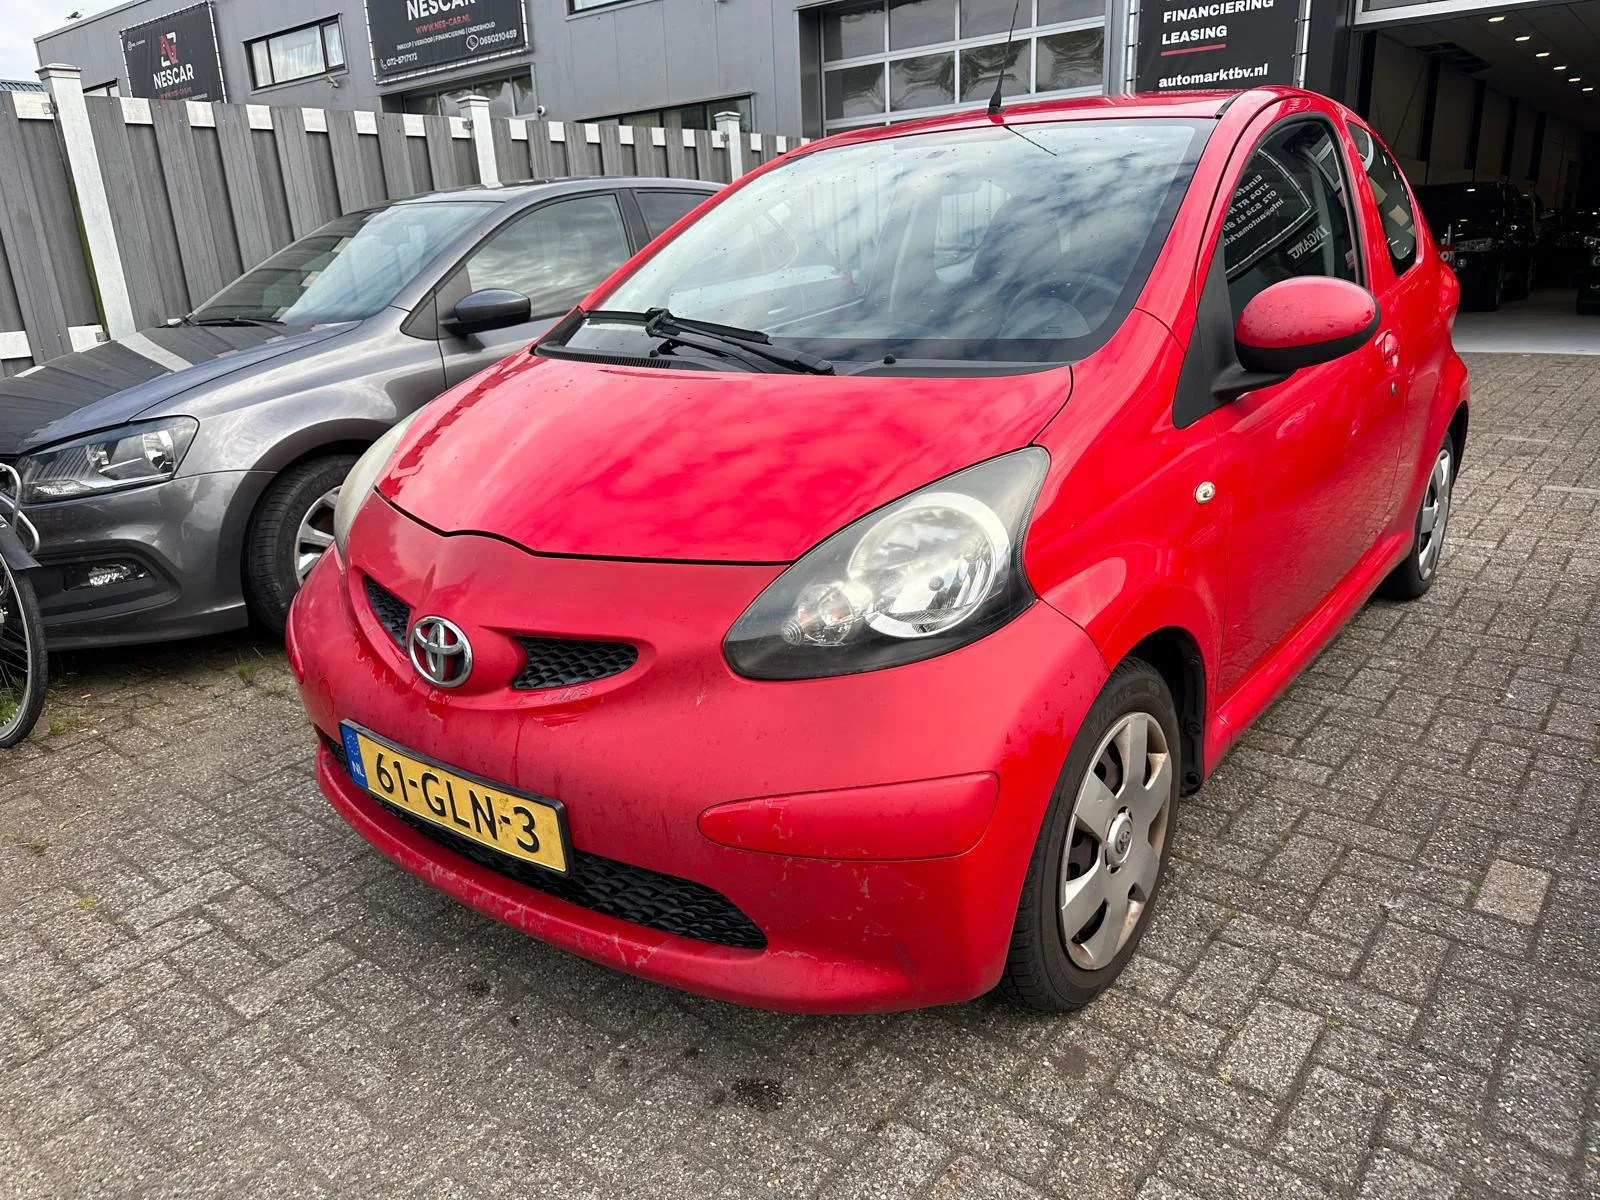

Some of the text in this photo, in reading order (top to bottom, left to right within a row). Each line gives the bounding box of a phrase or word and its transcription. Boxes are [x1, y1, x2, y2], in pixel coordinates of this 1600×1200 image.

[407, 0, 476, 21] NESC
[1163, 0, 1274, 23] FINANCIERING
[1161, 25, 1228, 45] LEASING
[152, 63, 195, 90] NESCAR
[1158, 63, 1269, 88] automarktbv.nl
[351, 760, 365, 778] NL
[376, 752, 540, 853] 61-GLN-3
